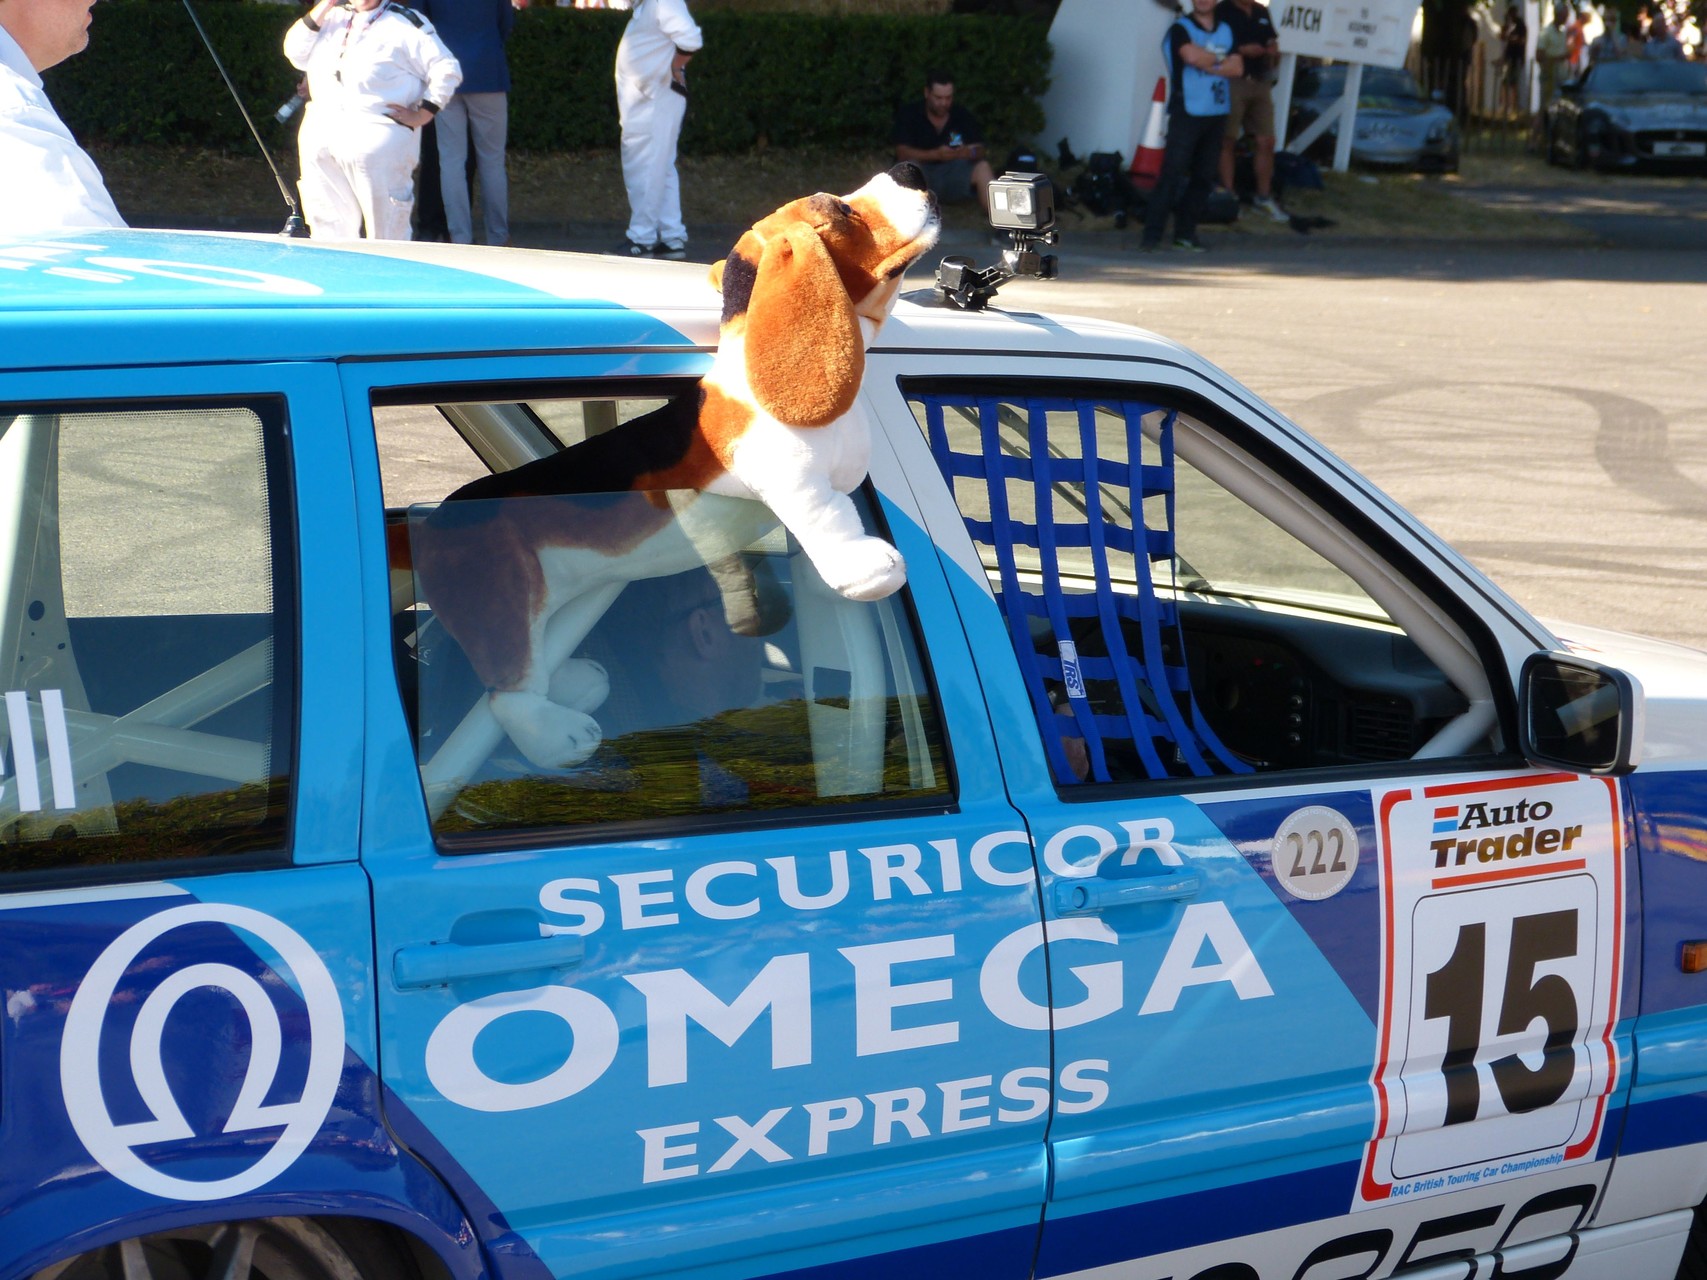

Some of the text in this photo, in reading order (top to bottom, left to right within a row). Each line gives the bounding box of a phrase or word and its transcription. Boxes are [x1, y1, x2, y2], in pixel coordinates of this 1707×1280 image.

[1286, 828, 1346, 877] 222
[1430, 824, 1583, 868] Trader
[1458, 798, 1553, 830] Auto
[537, 817, 1184, 937] SECURICOR
[424, 900, 1275, 1113] OMEGA
[1425, 908, 1579, 1127] 15
[636, 1059, 1110, 1185] EXPRESS
[1391, 1152, 1564, 1198] RAC British Touring Car Championship
